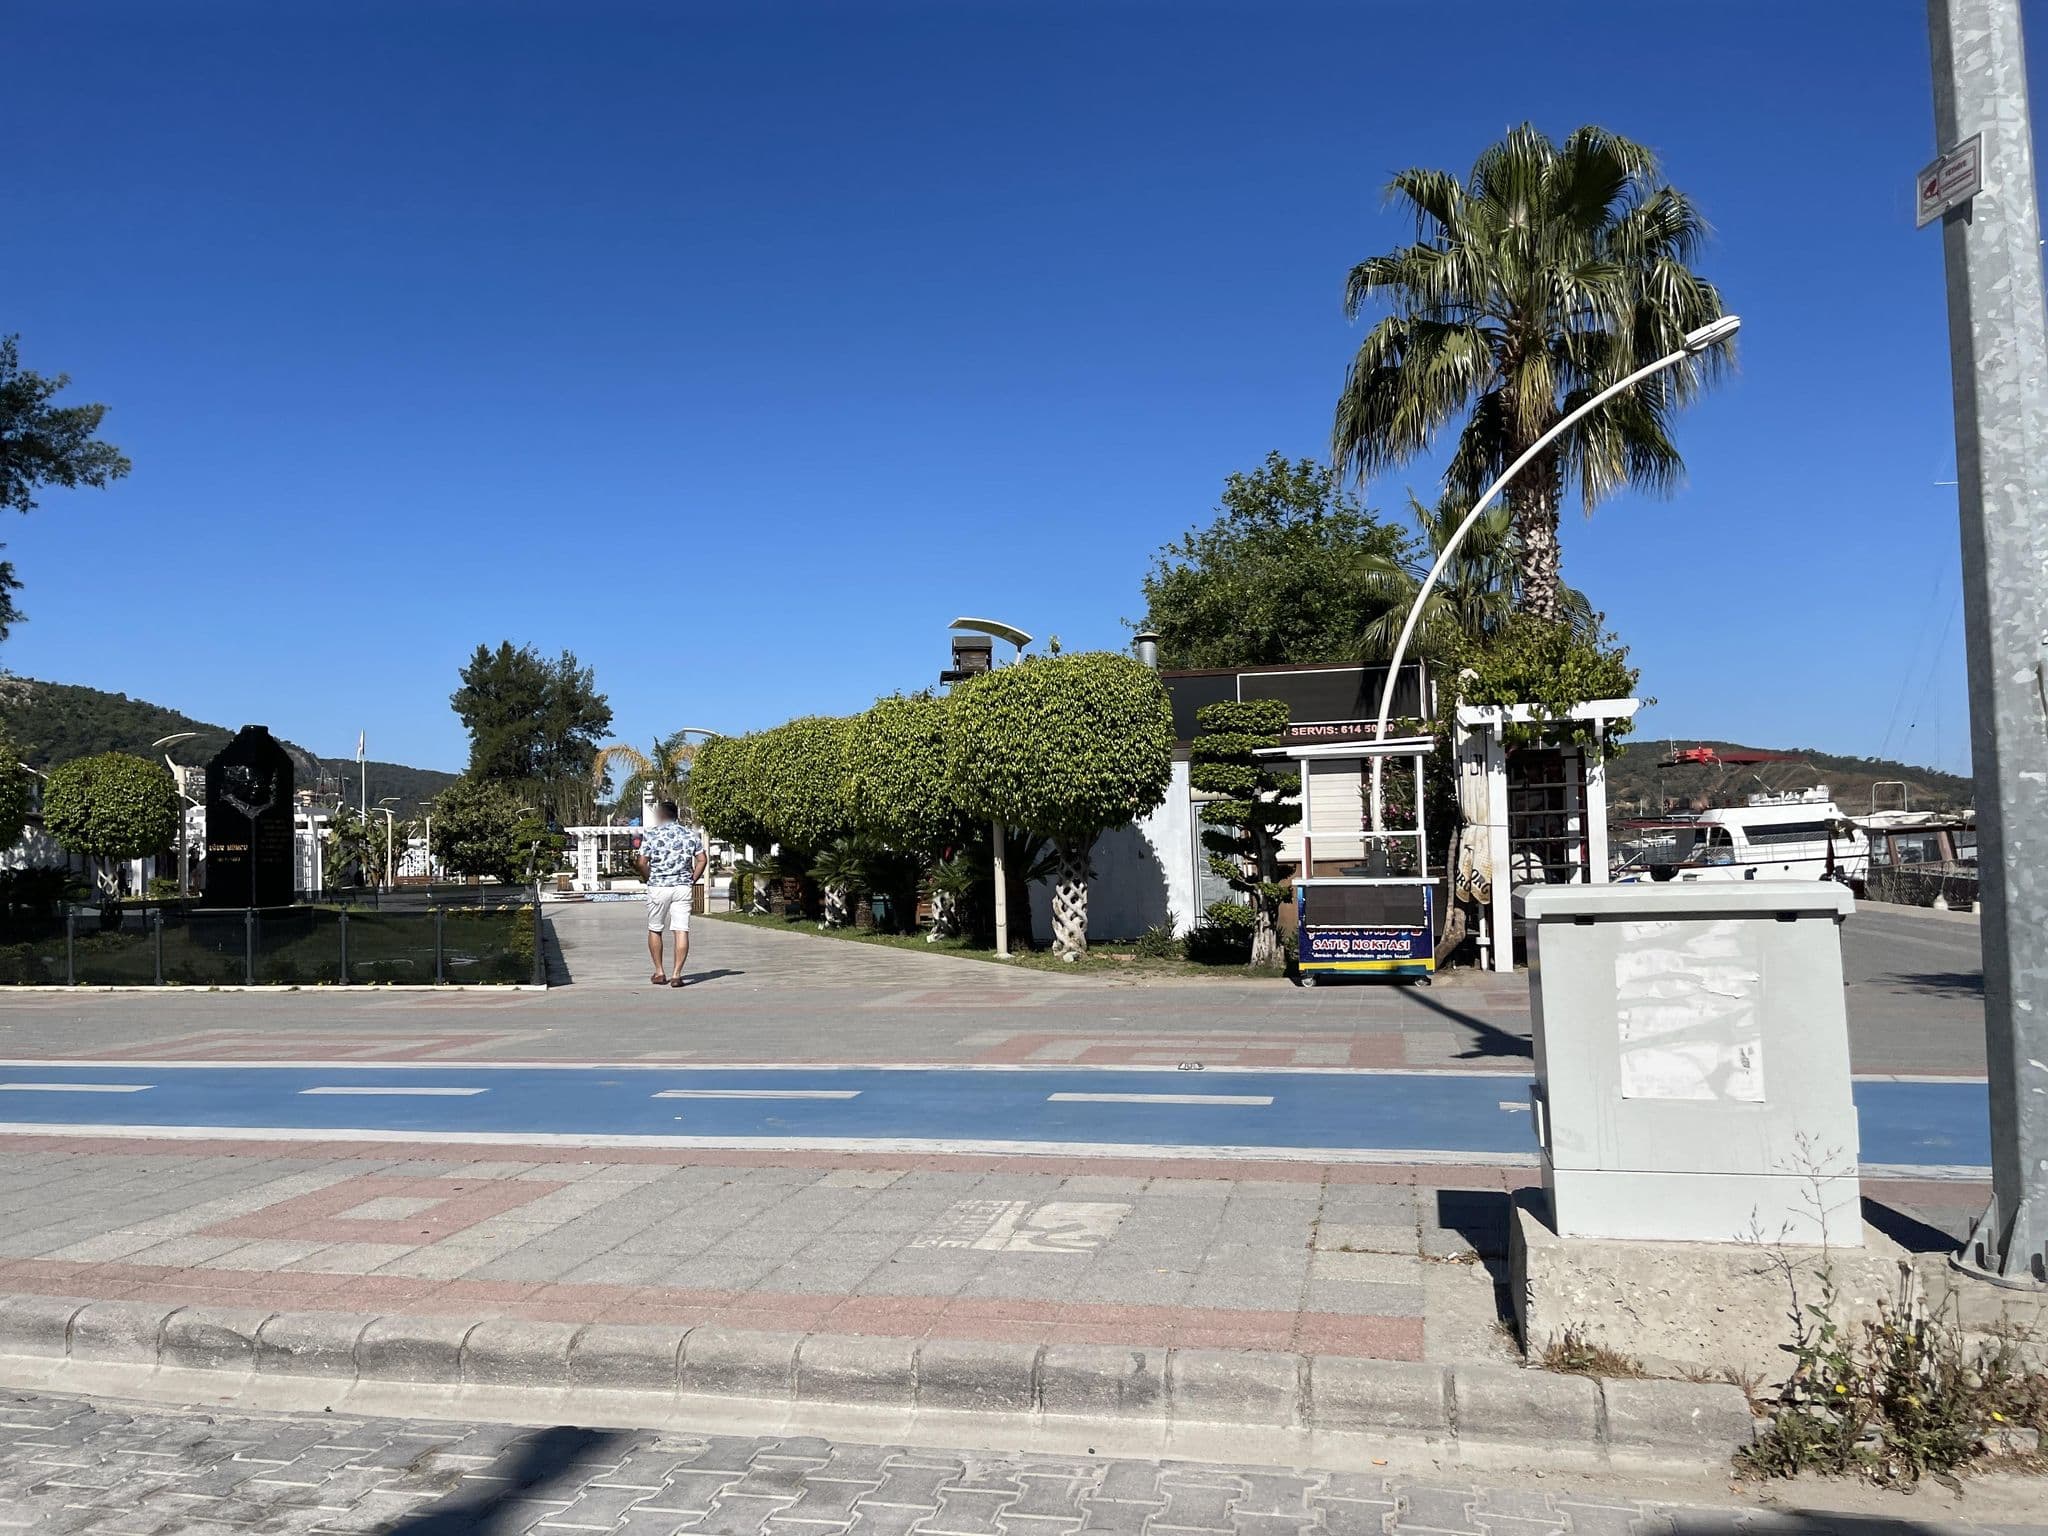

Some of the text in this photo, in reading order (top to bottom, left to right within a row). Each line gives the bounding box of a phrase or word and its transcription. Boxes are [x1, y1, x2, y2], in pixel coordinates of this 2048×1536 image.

[1341, 725, 1361, 734] 614
[1364, 724, 1377, 733] 50
[1313, 938, 1411, 953] SATIŞ NOKTASI
